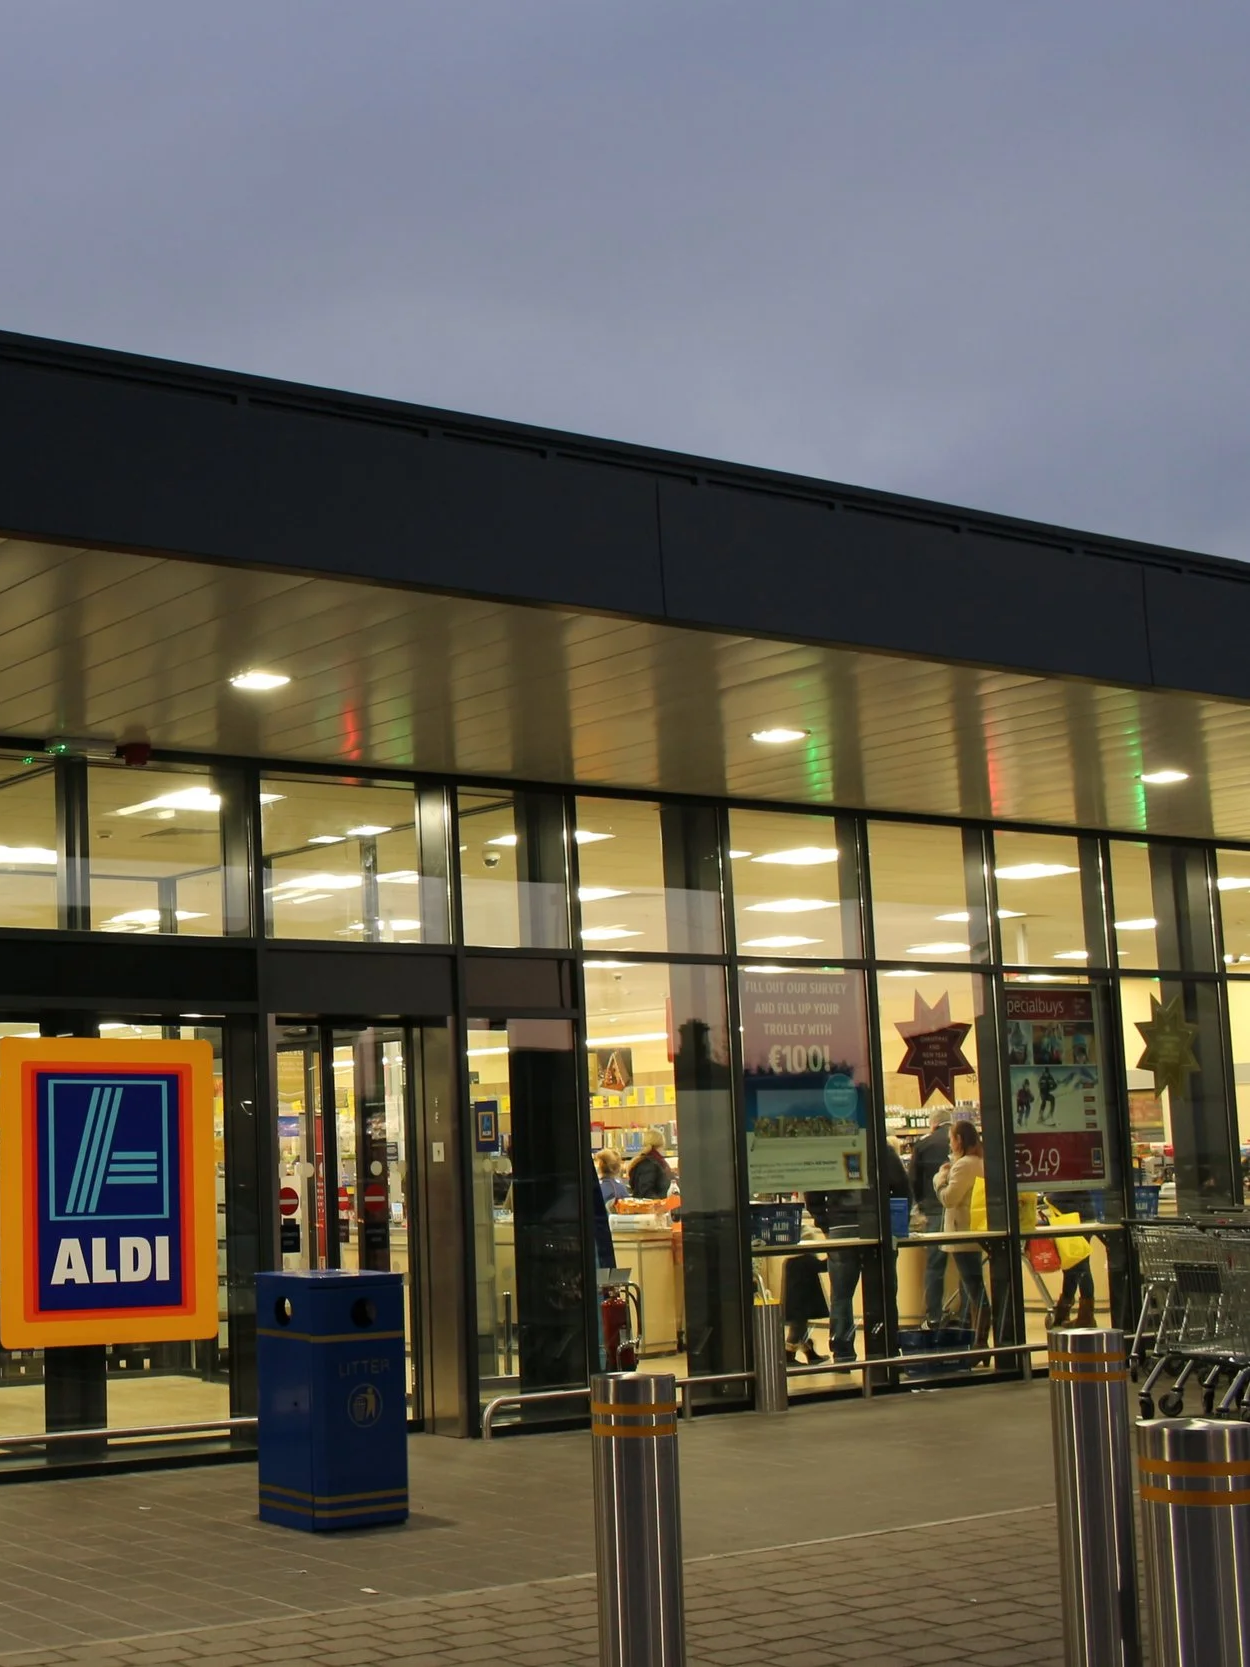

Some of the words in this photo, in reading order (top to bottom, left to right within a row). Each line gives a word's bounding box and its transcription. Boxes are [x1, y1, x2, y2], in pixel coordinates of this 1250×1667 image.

[745, 981, 764, 993] FILL
[765, 981, 784, 994] OUT
[787, 982, 807, 994] OUR
[810, 982, 847, 996] SURVEY
[754, 1002, 775, 1014] AND
[777, 1003, 796, 1015] FILL
[798, 1003, 811, 1015] UP
[813, 1003, 839, 1016] YOUR
[1006, 996, 1064, 1017] pecialbuys
[763, 1023, 805, 1036] TROLLEY
[807, 1023, 832, 1036] WITH
[769, 1044, 831, 1074] €100!
[773, 1222, 789, 1231] ALDI
[50, 1235, 170, 1286] ALDI
[339, 1358, 392, 1379] LITTER
